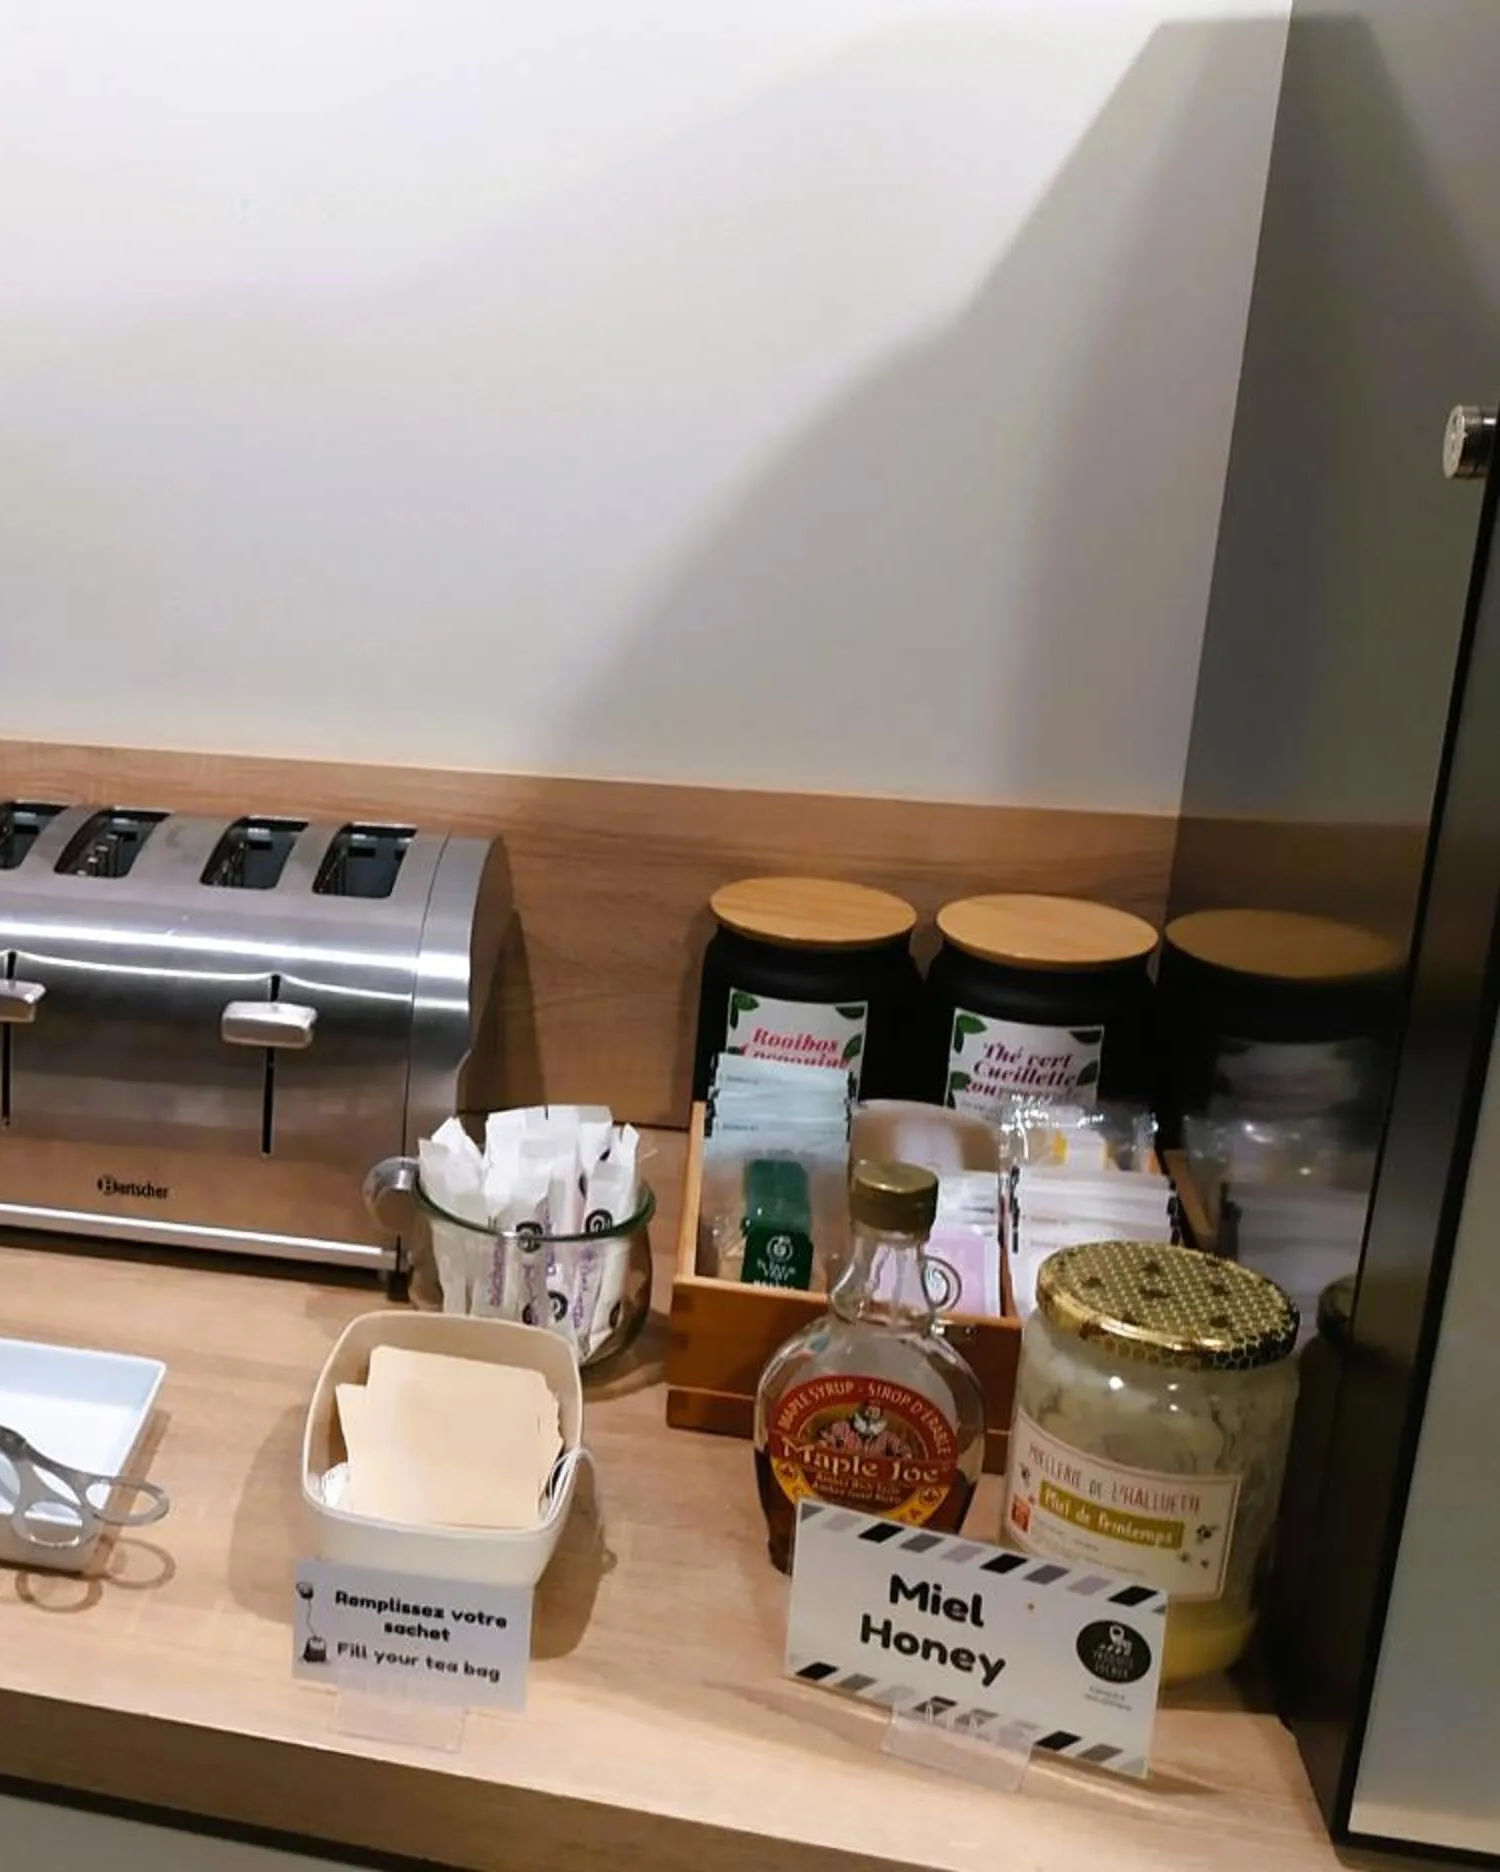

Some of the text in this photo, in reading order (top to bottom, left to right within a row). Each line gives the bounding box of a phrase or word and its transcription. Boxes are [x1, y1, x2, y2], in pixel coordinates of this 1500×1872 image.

[752, 1027, 838, 1052] Rooibos
[983, 1041, 1074, 1069] Thé vert
[973, 1060, 1076, 1086] Cueillette
[777, 1392, 812, 1431] MAPLE
[808, 1380, 855, 1400] SYRUP
[868, 1382, 911, 1406] SIROP
[781, 1437, 940, 1484] Maple Joe
[1045, 1488, 1072, 1517] Miel
[1075, 1504, 1090, 1526] de
[335, 1590, 508, 1629] Remplissez votre
[889, 1574, 985, 1628] Miel
[384, 1620, 451, 1643] sachet
[860, 1613, 1007, 1688] Honey
[336, 1641, 501, 1684] Fill your tea bag
